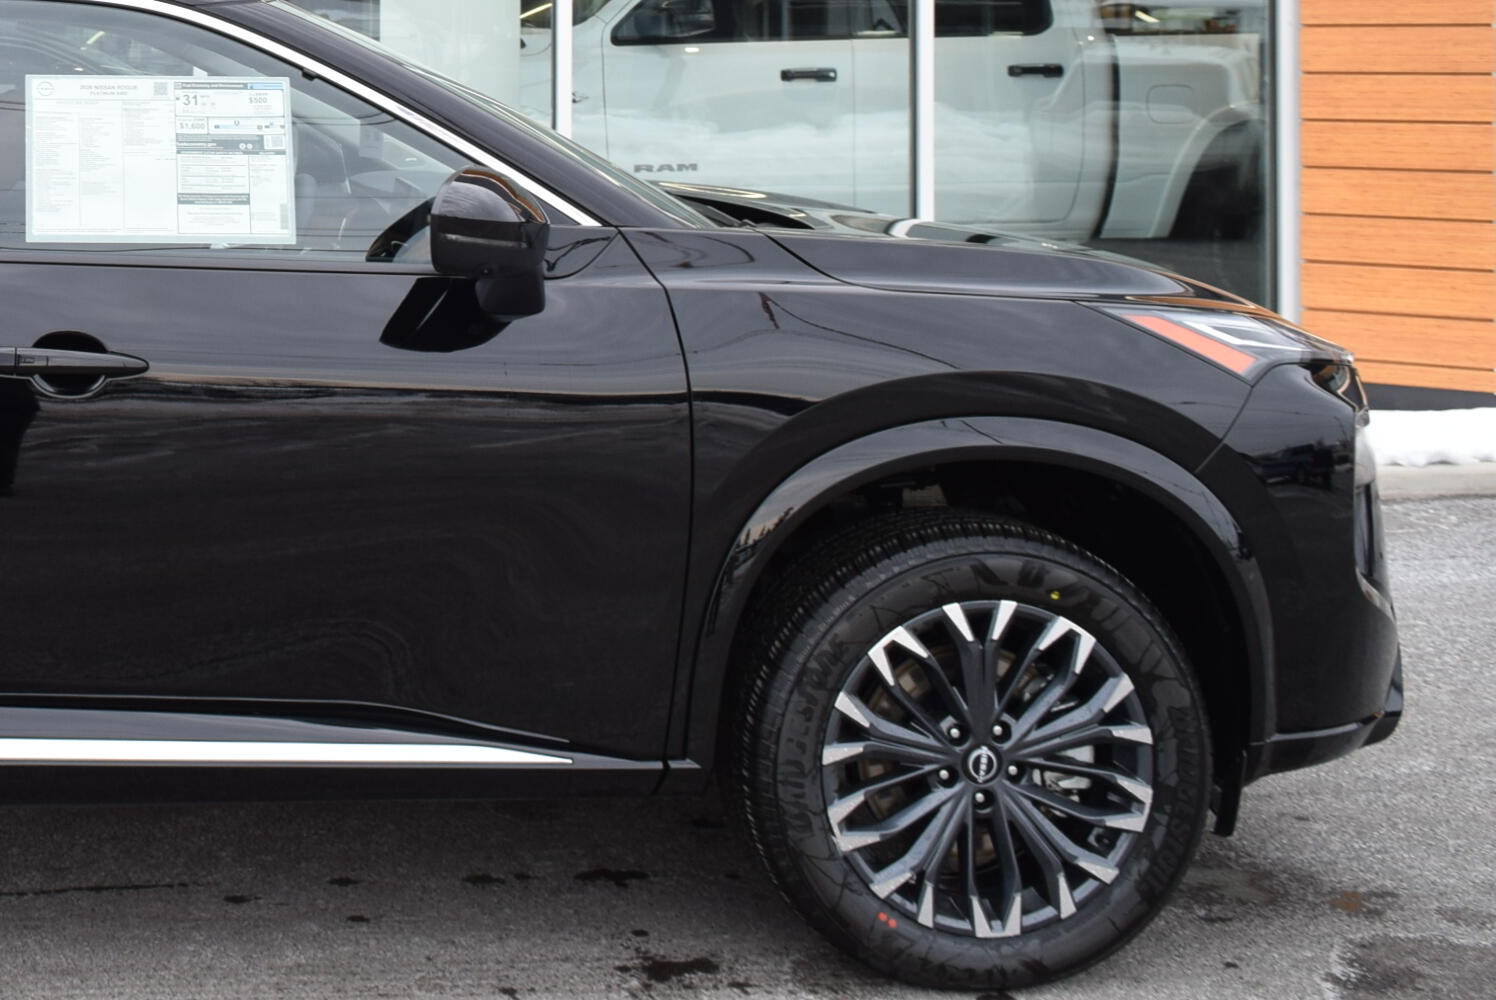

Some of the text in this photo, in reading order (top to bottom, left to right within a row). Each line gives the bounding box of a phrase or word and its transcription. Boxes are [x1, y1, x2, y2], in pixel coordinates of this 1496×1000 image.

[182, 94, 198, 106] 31
[248, 96, 268, 104] $500
[634, 163, 698, 173] RAM
